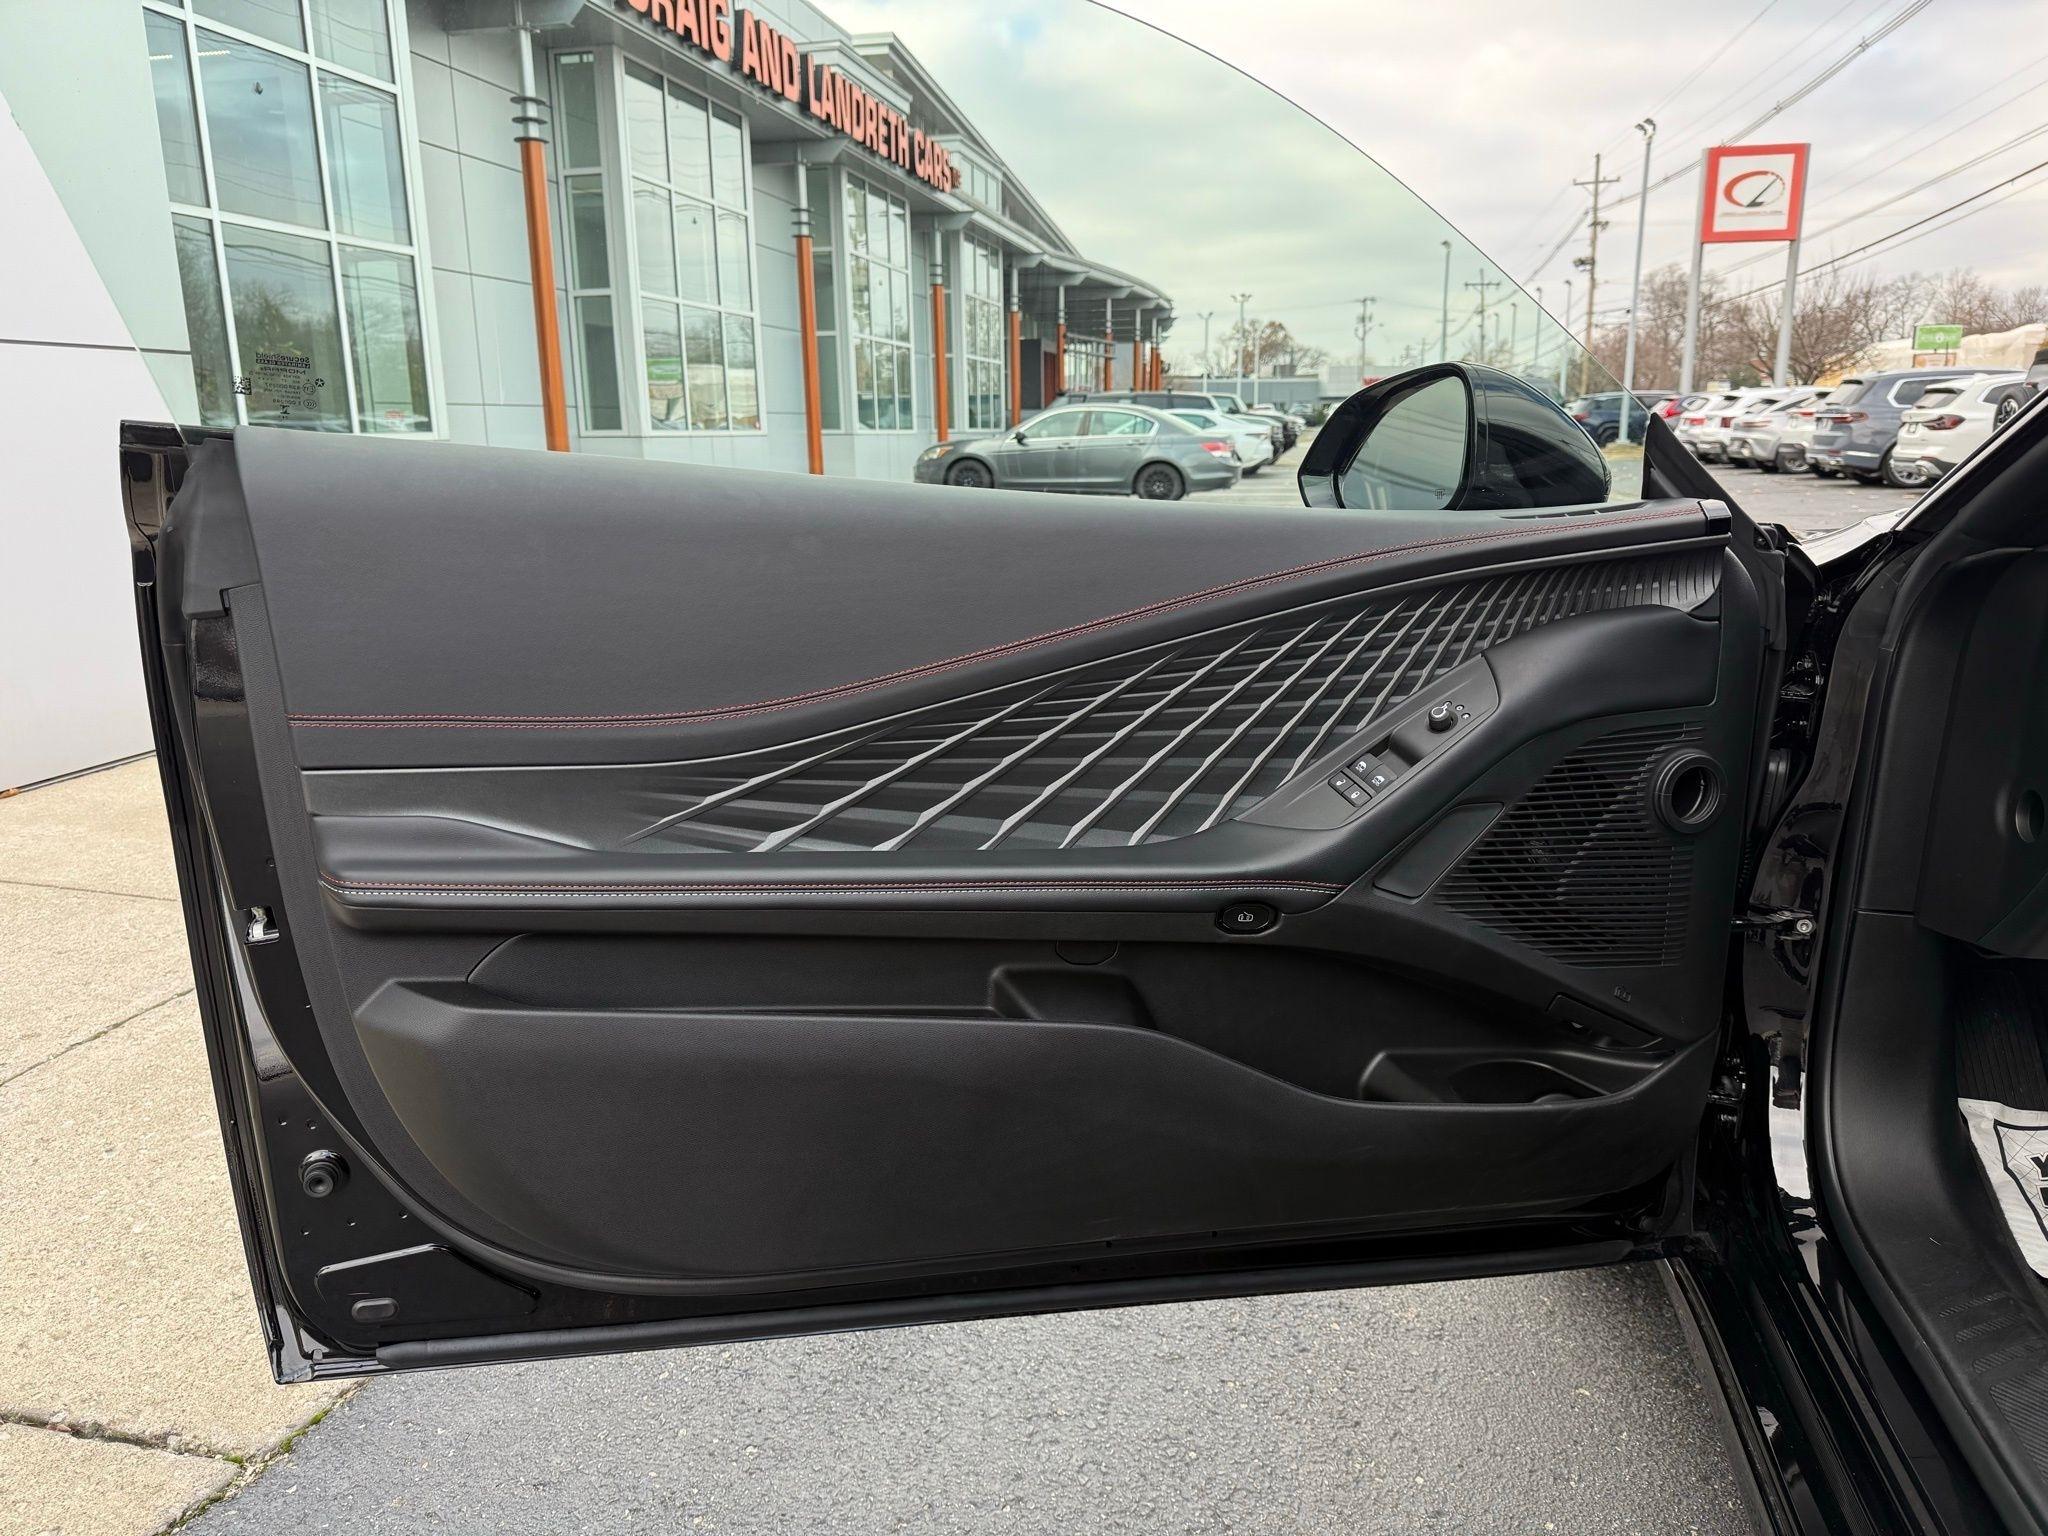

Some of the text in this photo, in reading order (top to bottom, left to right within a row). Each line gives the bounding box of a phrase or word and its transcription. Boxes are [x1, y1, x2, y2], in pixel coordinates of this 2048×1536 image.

[627, 0, 951, 193] AIG AND LANDRETH CARS
